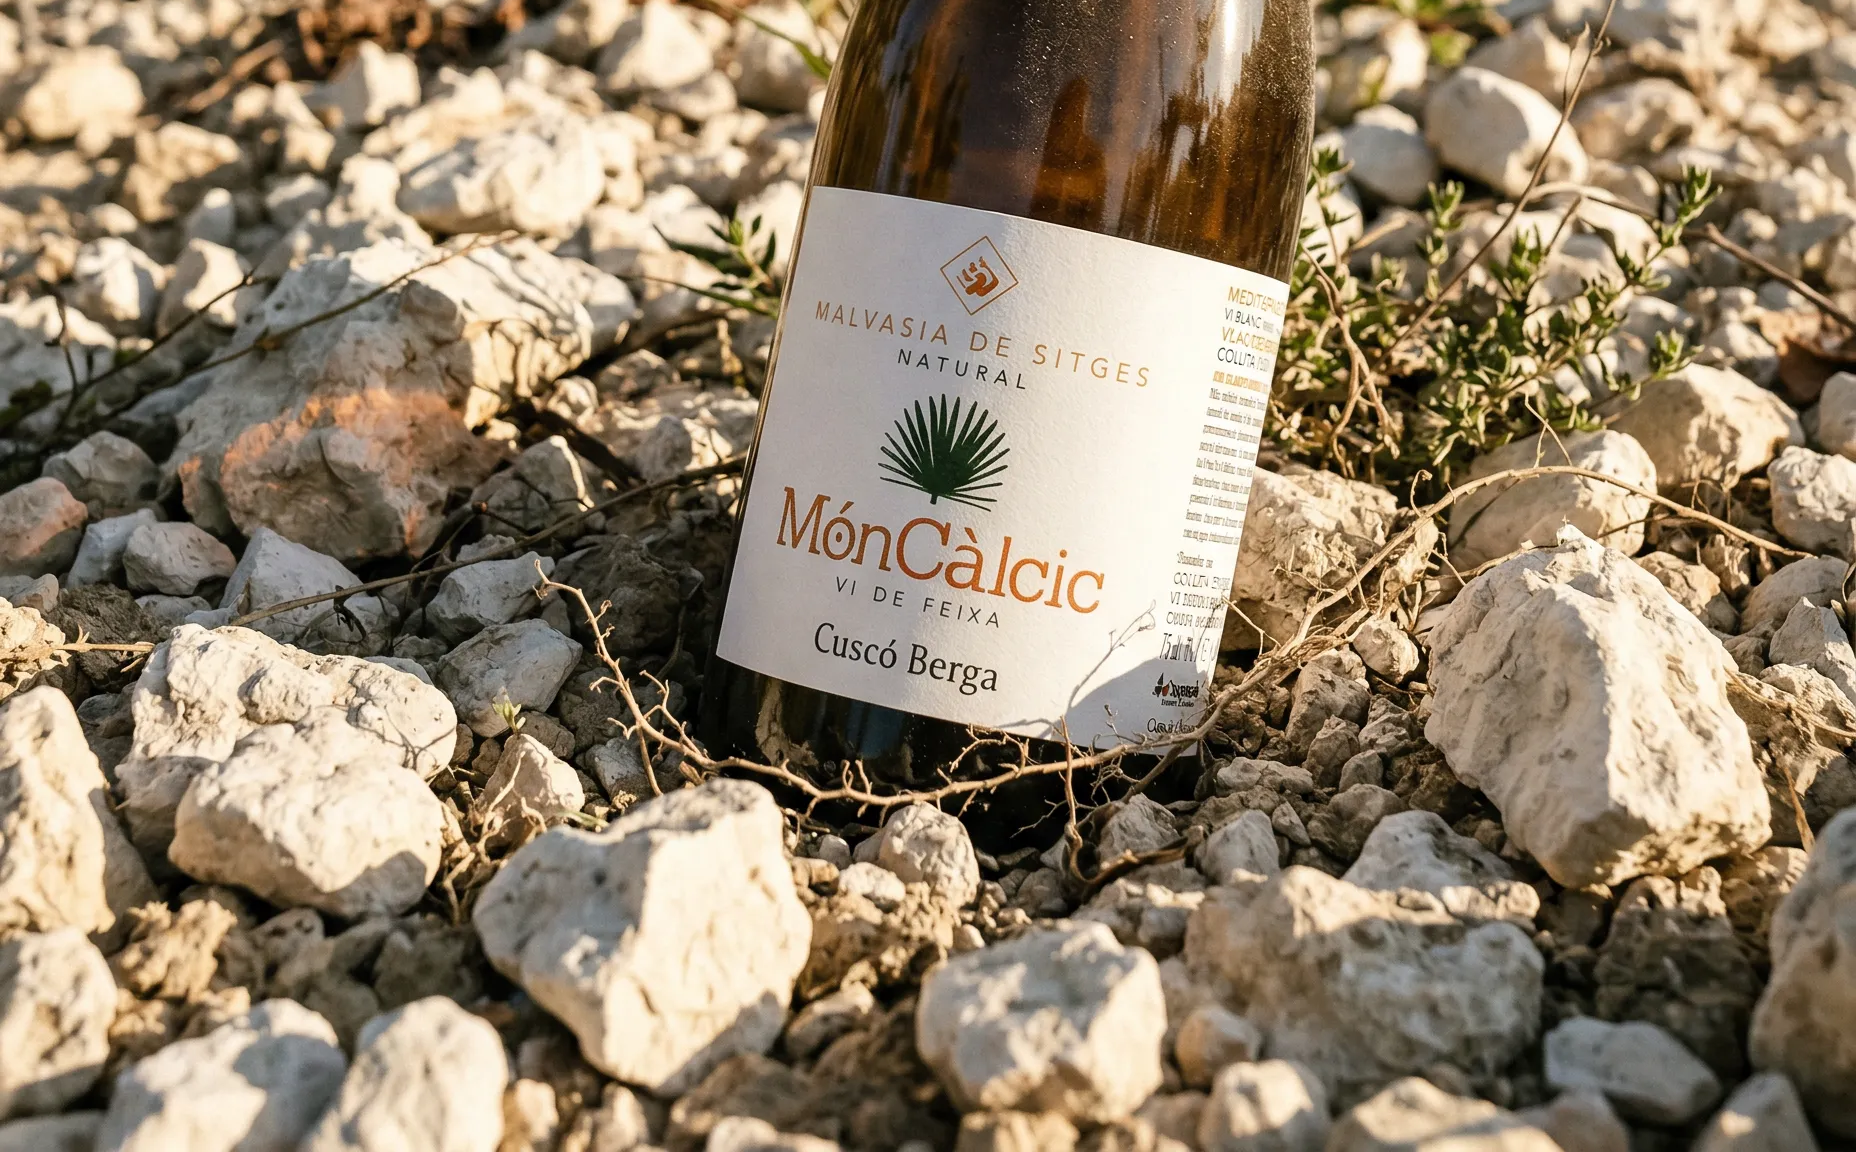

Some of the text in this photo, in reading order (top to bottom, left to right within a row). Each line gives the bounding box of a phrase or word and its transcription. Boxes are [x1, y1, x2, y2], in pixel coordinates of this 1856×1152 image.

[814, 300, 1150, 388] MALVASIA DE SITGES
[897, 348, 1027, 390] NATURAL
[776, 486, 1105, 614] MónCàlcic
[835, 576, 1000, 629] VI DE FEIXA
[814, 622, 999, 695] Cuscó Berga
